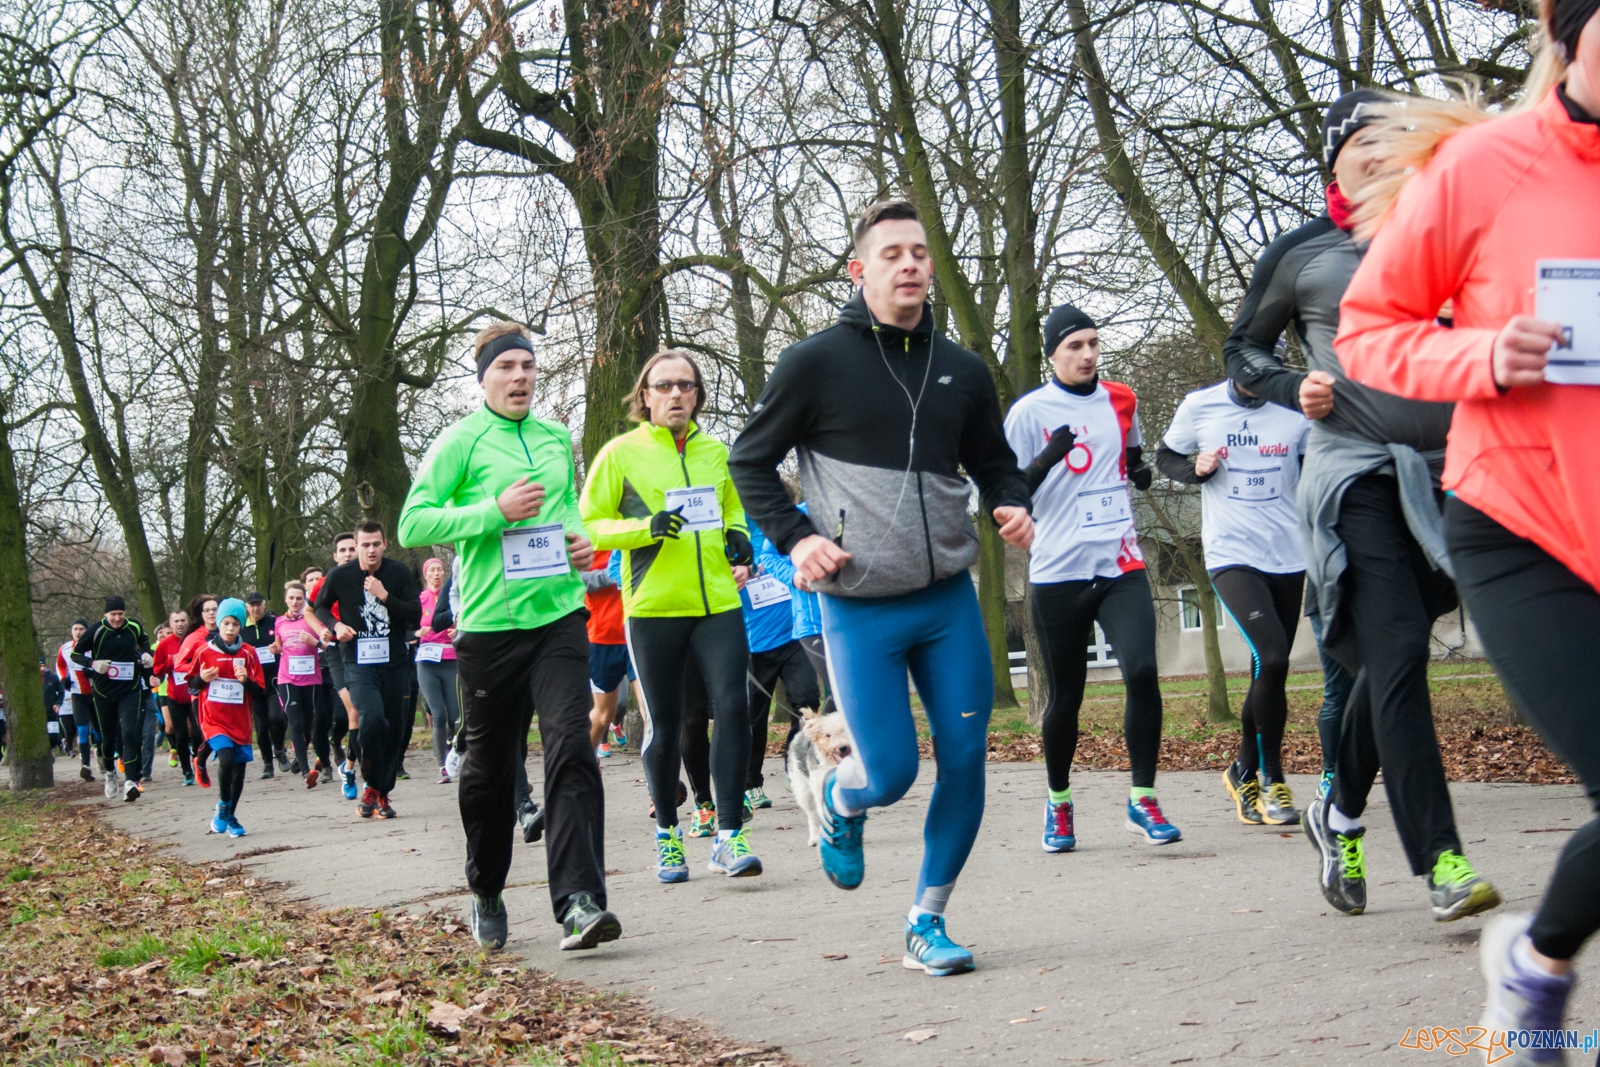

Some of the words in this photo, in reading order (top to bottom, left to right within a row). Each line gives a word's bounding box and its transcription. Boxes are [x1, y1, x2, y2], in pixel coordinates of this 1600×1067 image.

[1227, 433, 1258, 447] RUN
[1246, 476, 1265, 486] 398
[687, 496, 703, 508] 166
[1101, 496, 1112, 507] 67
[528, 536, 549, 549] 486
[761, 580, 775, 591] 336
